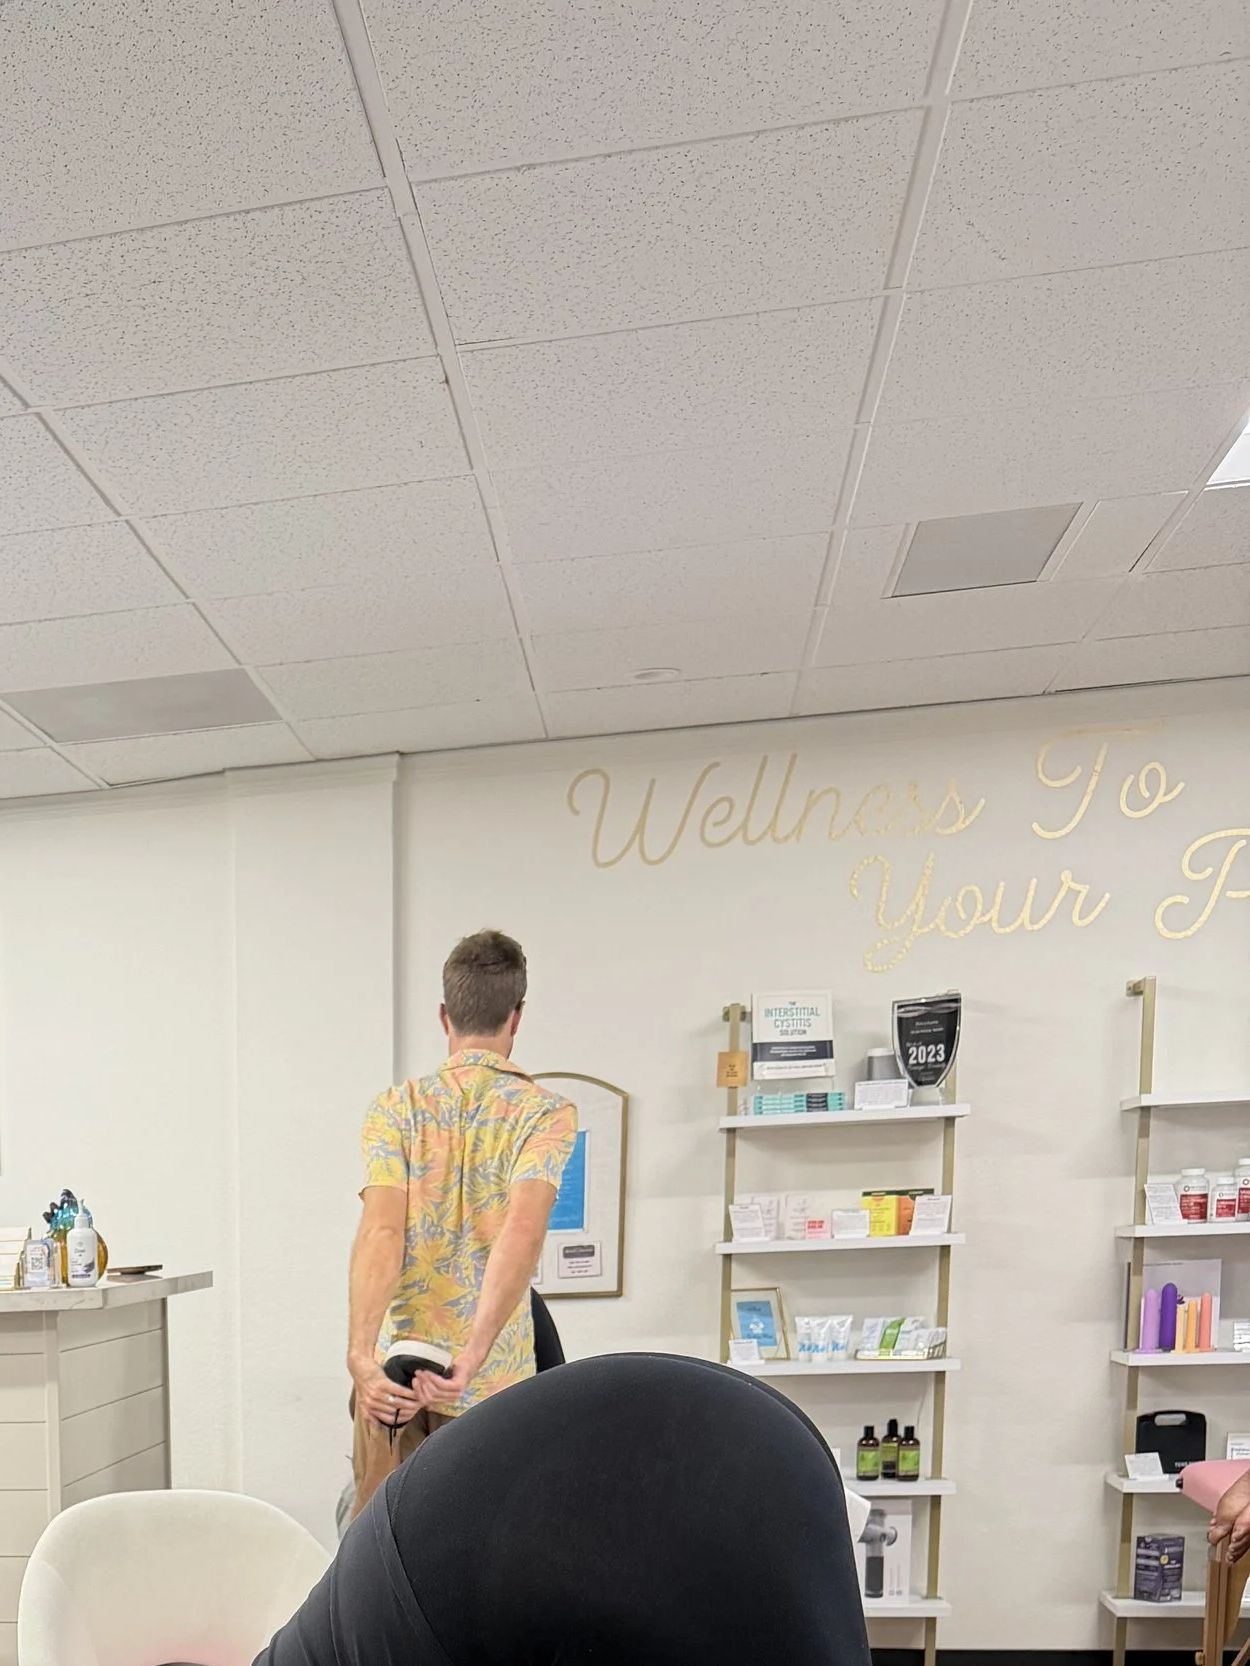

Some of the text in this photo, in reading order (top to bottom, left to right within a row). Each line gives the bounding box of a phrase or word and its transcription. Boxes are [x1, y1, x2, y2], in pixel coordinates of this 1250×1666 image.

[567, 723, 1186, 869] Wellness To
[851, 852, 1111, 974] Your
[764, 1007, 821, 1018] INTERSTITIAL
[774, 1018, 812, 1028] CYSTITIS
[909, 1044, 945, 1064] 2023
